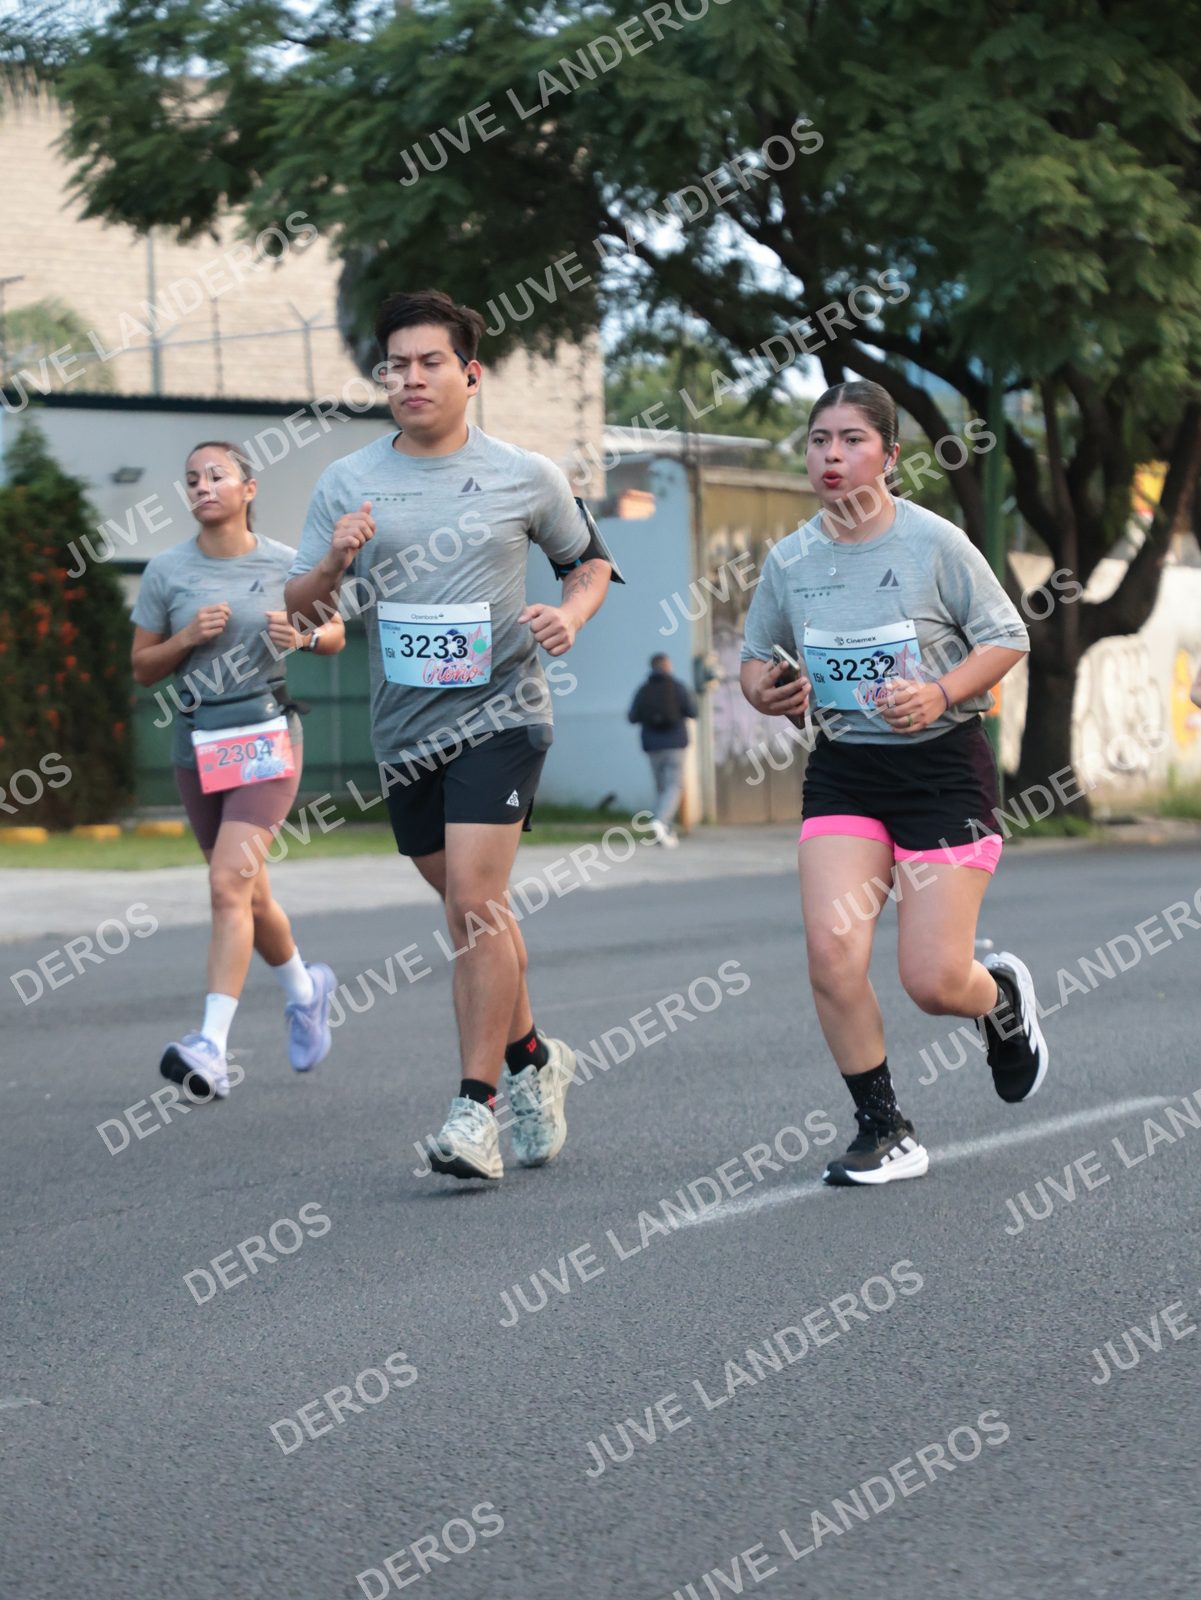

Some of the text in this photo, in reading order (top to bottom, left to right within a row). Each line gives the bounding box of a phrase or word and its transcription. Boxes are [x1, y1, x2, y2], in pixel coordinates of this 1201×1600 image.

[400, 634, 468, 659] 3233
[846, 636, 876, 644] Cinemex
[826, 655, 899, 681] 3232
[217, 740, 273, 766] 2304
